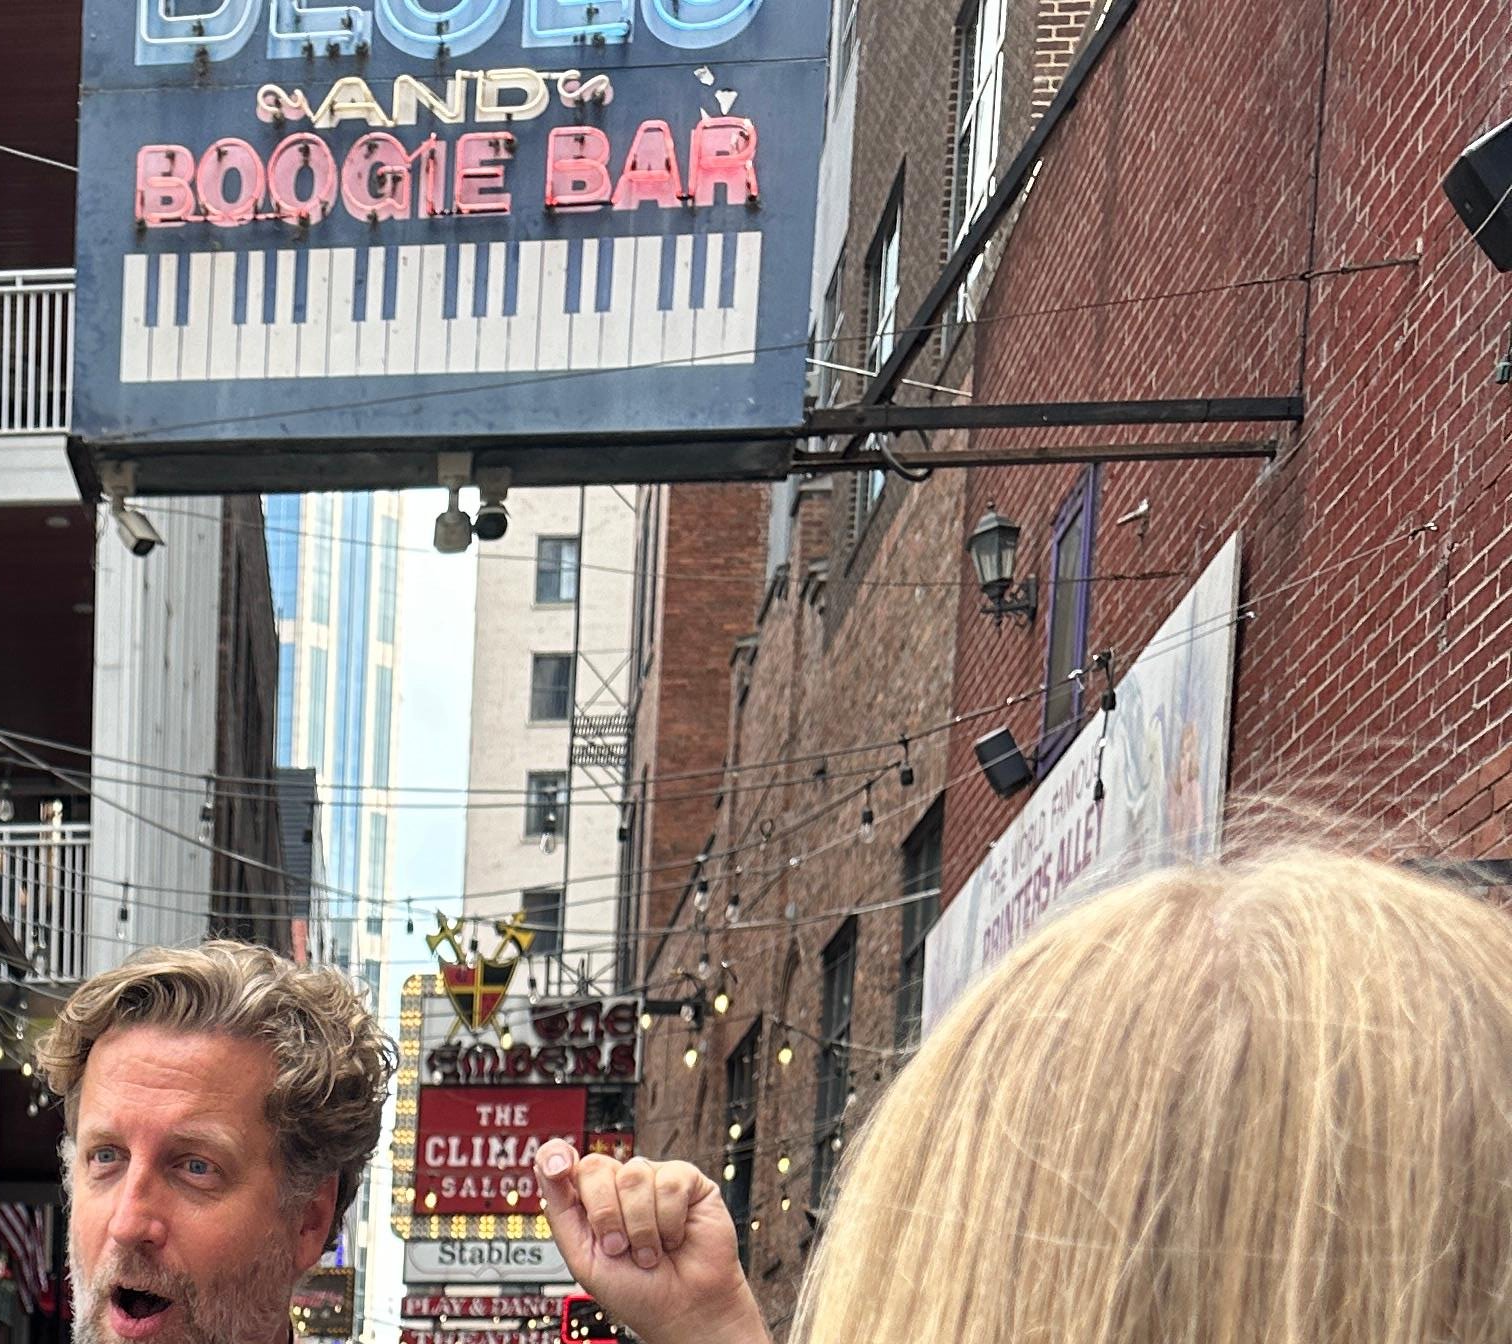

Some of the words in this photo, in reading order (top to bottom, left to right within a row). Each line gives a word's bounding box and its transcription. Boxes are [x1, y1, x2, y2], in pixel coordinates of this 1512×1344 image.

[311, 67, 550, 129] AND
[135, 131, 517, 228] BOOGIE
[545, 113, 761, 212] BAR
[1011, 809, 1047, 880] WORLD
[1053, 786, 1105, 901] ALLEY
[476, 1104, 529, 1127] THE
[425, 1135, 576, 1168] CLIMA
[441, 1175, 542, 1199] SALOO
[438, 1240, 543, 1266] Stables
[405, 1298, 463, 1316] PLAY
[469, 1298, 486, 1316] &
